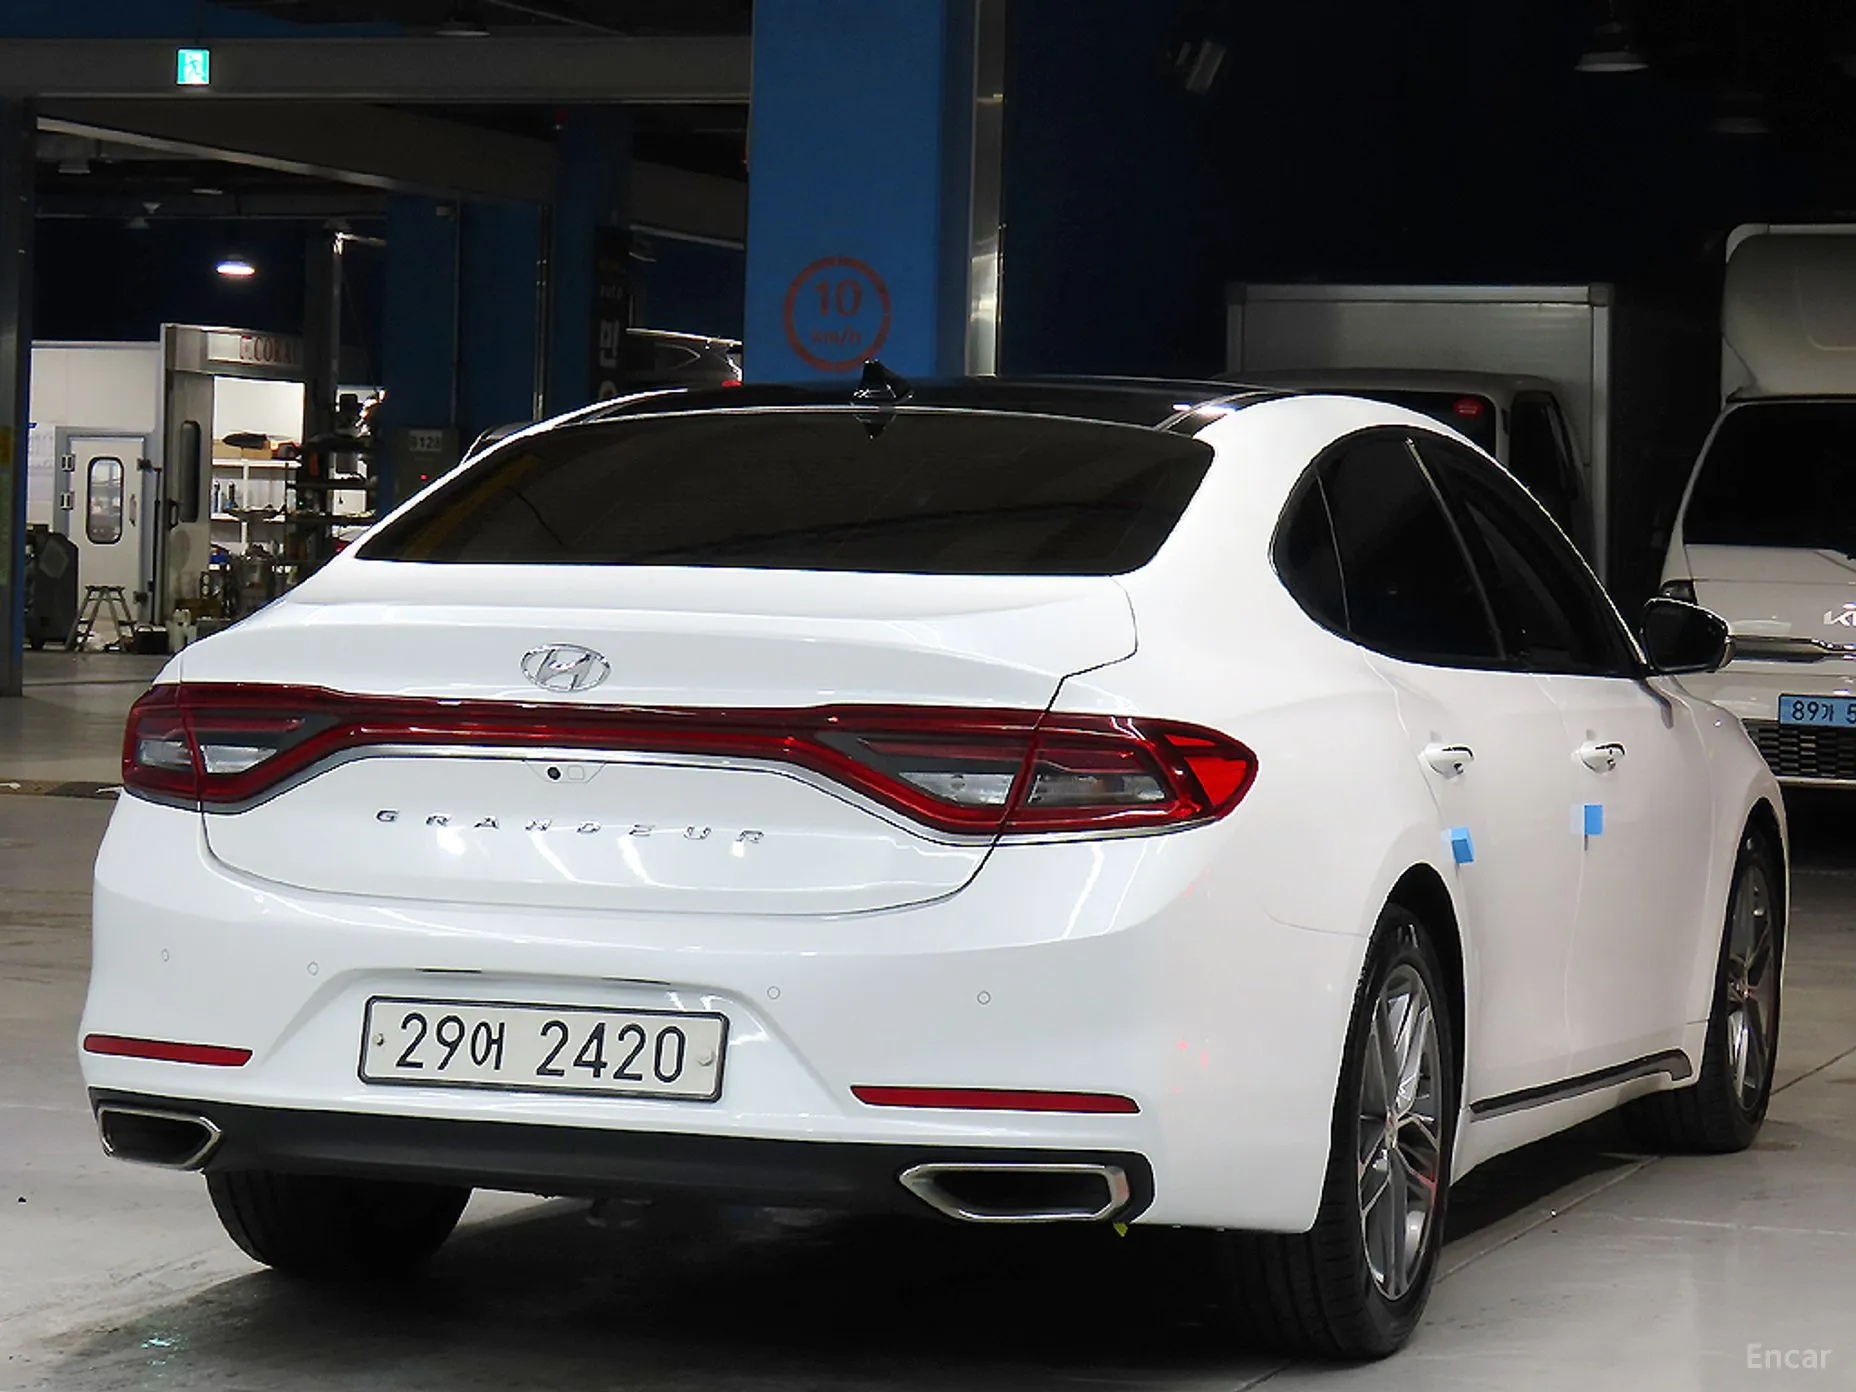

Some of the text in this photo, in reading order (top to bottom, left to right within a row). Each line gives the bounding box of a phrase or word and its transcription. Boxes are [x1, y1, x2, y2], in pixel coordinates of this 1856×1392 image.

[815, 279, 862, 317] 10
[811, 325, 862, 346] km/h
[1792, 699, 1834, 722] 89가
[375, 809, 765, 843] GRANDEUR
[395, 1011, 687, 1083] 29어 2420
